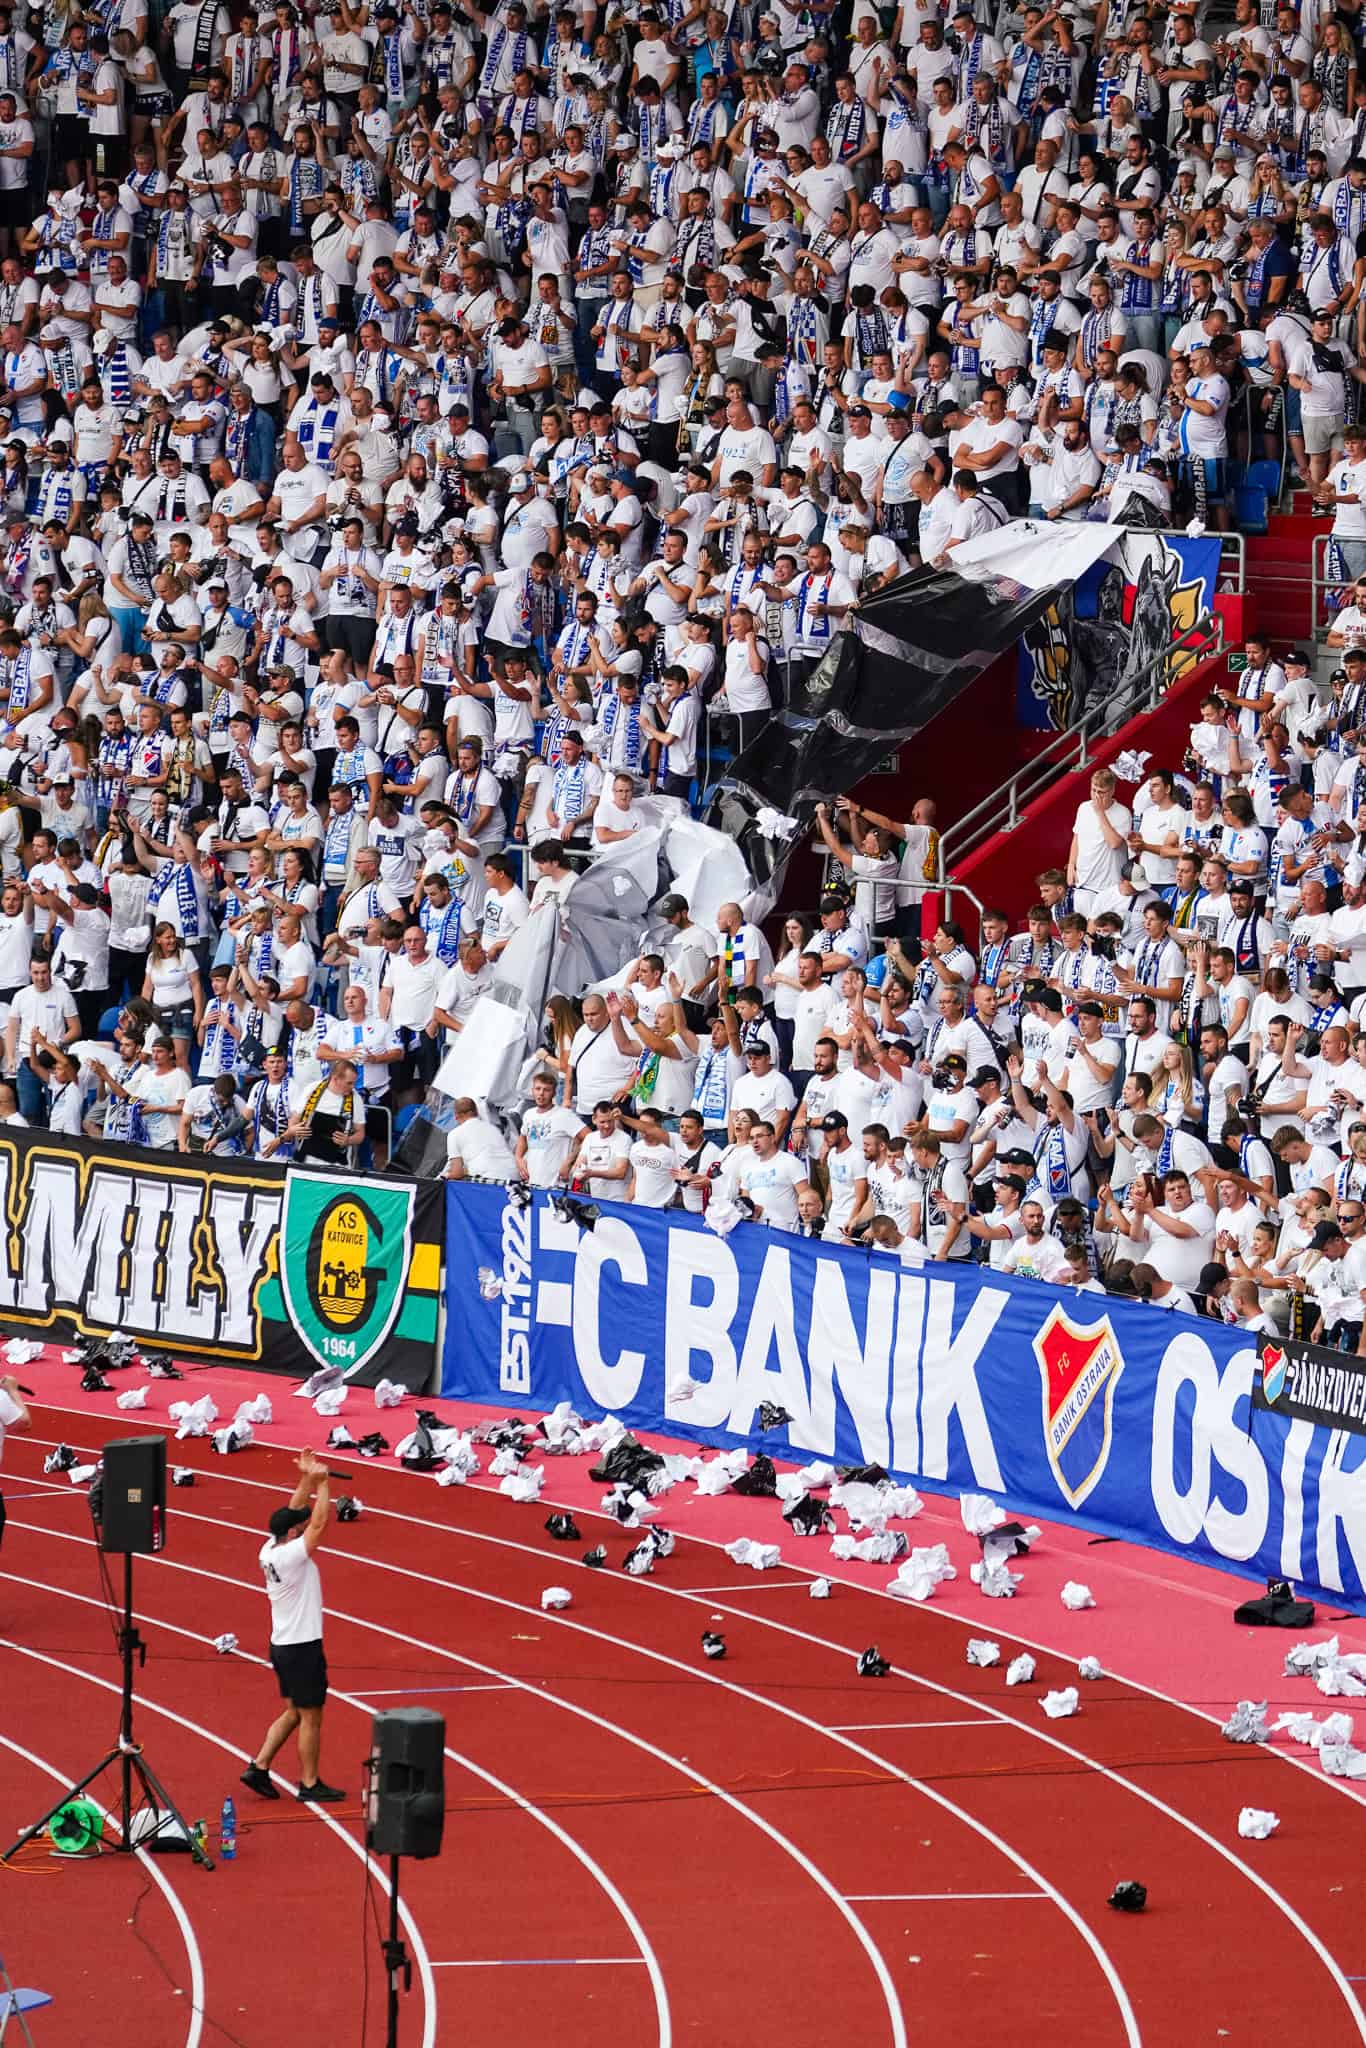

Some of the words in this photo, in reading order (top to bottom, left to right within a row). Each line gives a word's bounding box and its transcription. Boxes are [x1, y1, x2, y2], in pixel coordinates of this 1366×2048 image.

[338, 1211, 357, 1230] KS
[328, 1231, 364, 1245] KATOWICE
[0, 1156, 282, 1345] MILY
[321, 1337, 357, 1359] 1964
[1057, 1352, 1071, 1377] FC
[1053, 1403, 1078, 1445] BANÍK
[1076, 1349, 1112, 1407] OSTRAVA
